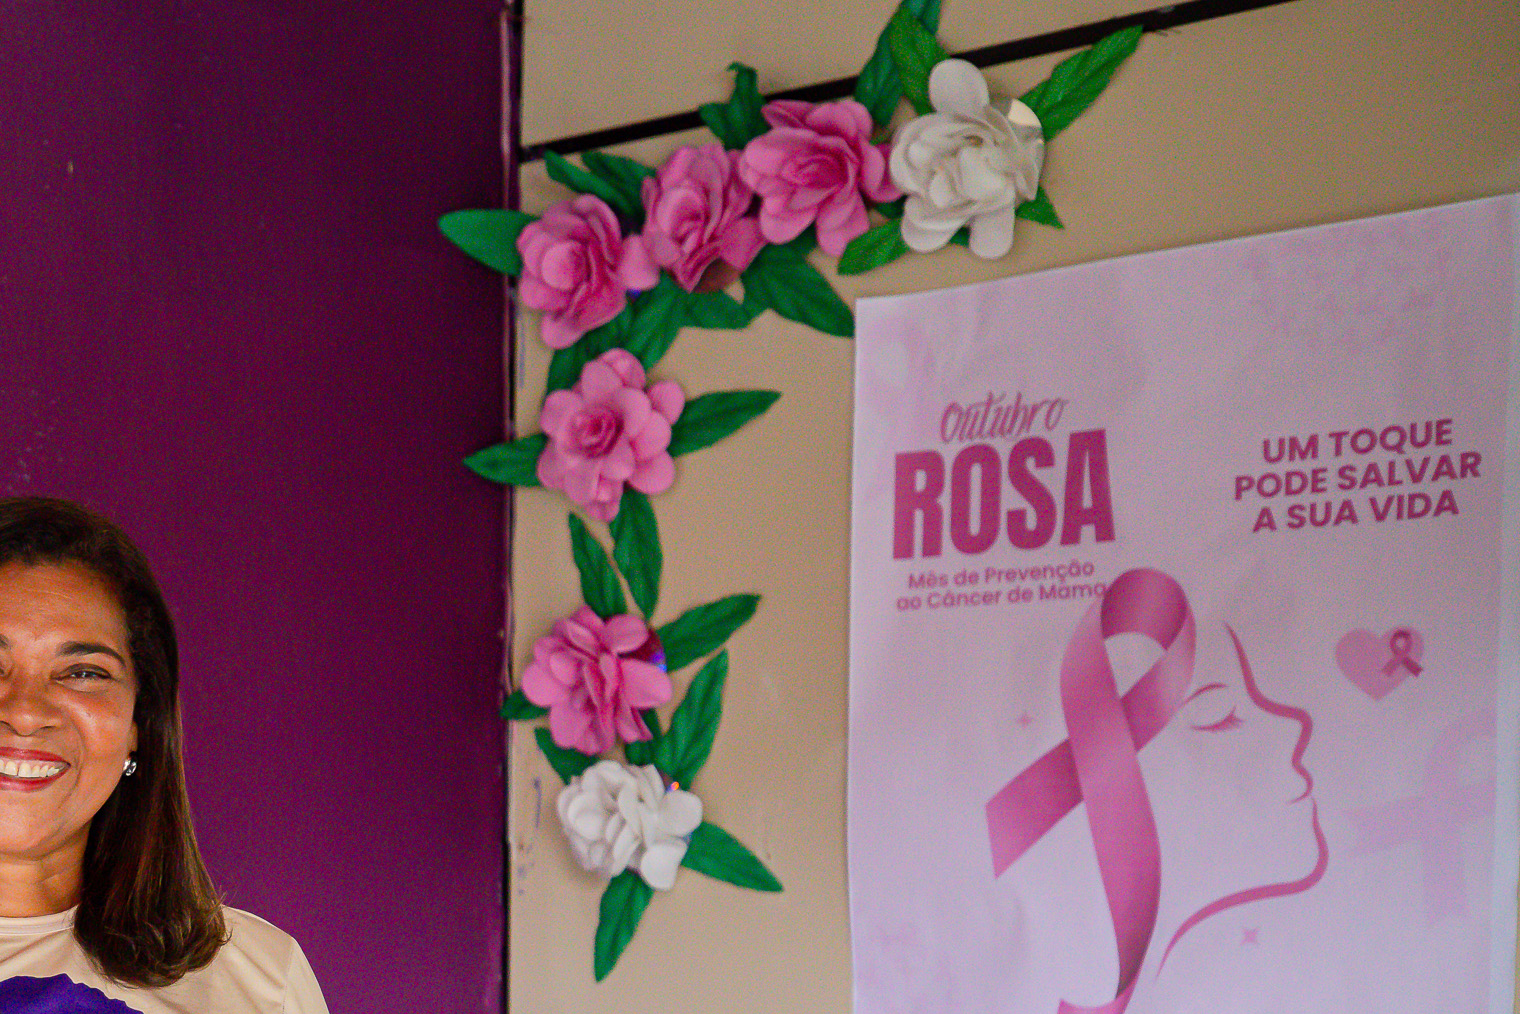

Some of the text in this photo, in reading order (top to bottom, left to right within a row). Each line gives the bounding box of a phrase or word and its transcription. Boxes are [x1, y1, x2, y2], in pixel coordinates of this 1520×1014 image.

[1263, 418, 1452, 463] UM TOQUE
[893, 428, 1115, 560] ROSA
[1234, 451, 1481, 500] PODE SALVAR
[1253, 489, 1459, 533] A SUA VIDA
[908, 559, 1094, 589] Mês de Prevenção
[896, 582, 1107, 611] ao Câncer de Mama
